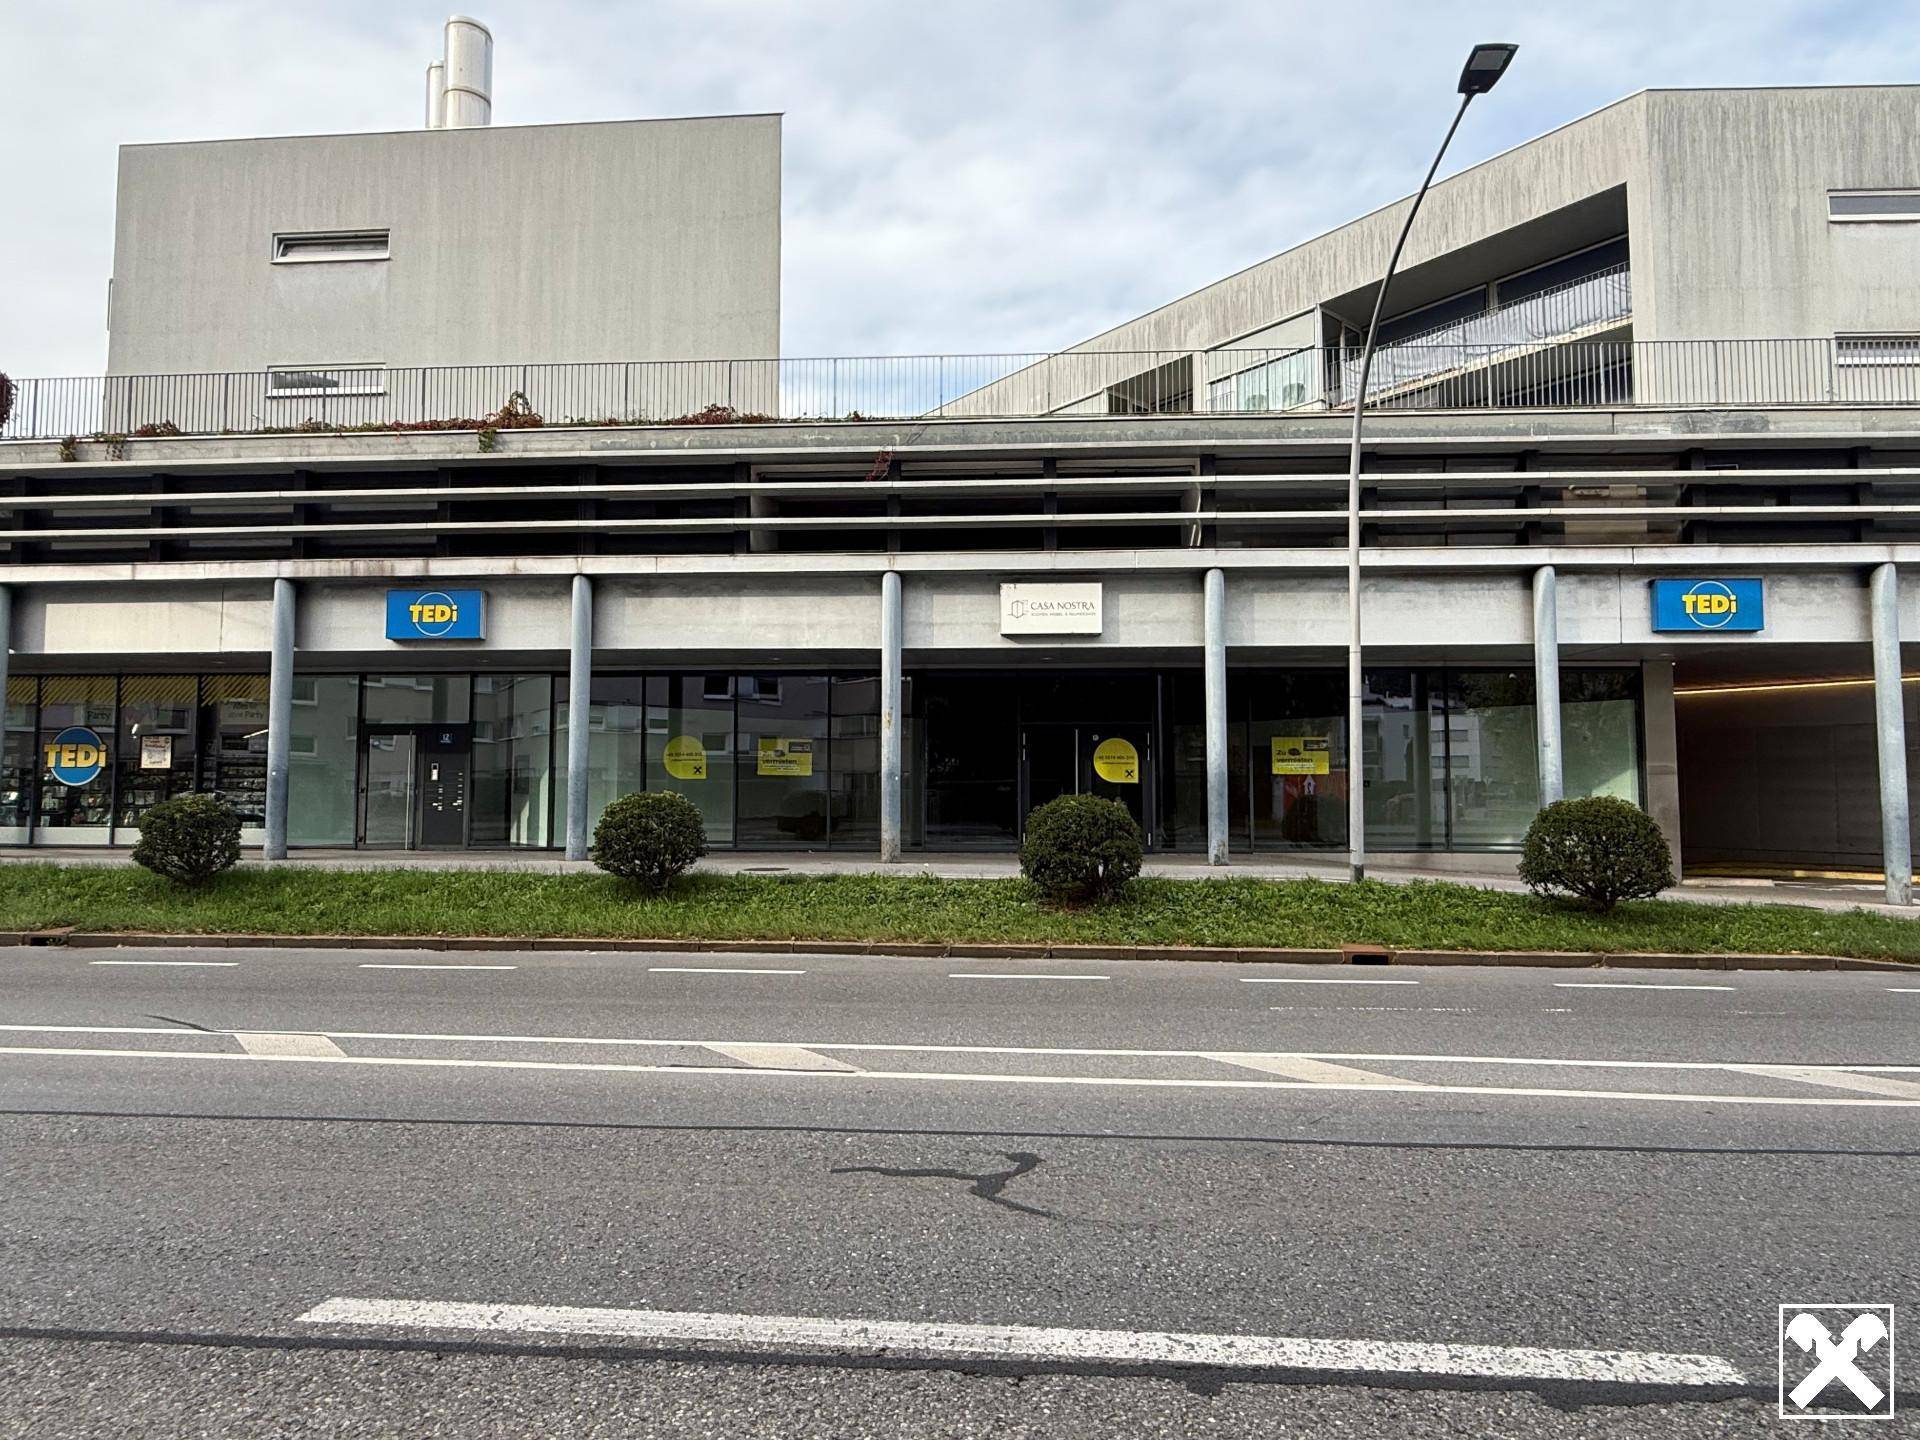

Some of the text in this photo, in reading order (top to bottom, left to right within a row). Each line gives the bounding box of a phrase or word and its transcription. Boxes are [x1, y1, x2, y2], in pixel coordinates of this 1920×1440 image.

[409, 604, 458, 623] TEDi
[1030, 601, 1095, 611] CASA NOSTRA
[1682, 594, 1737, 614] TEDi
[44, 743, 107, 769] TEDi
